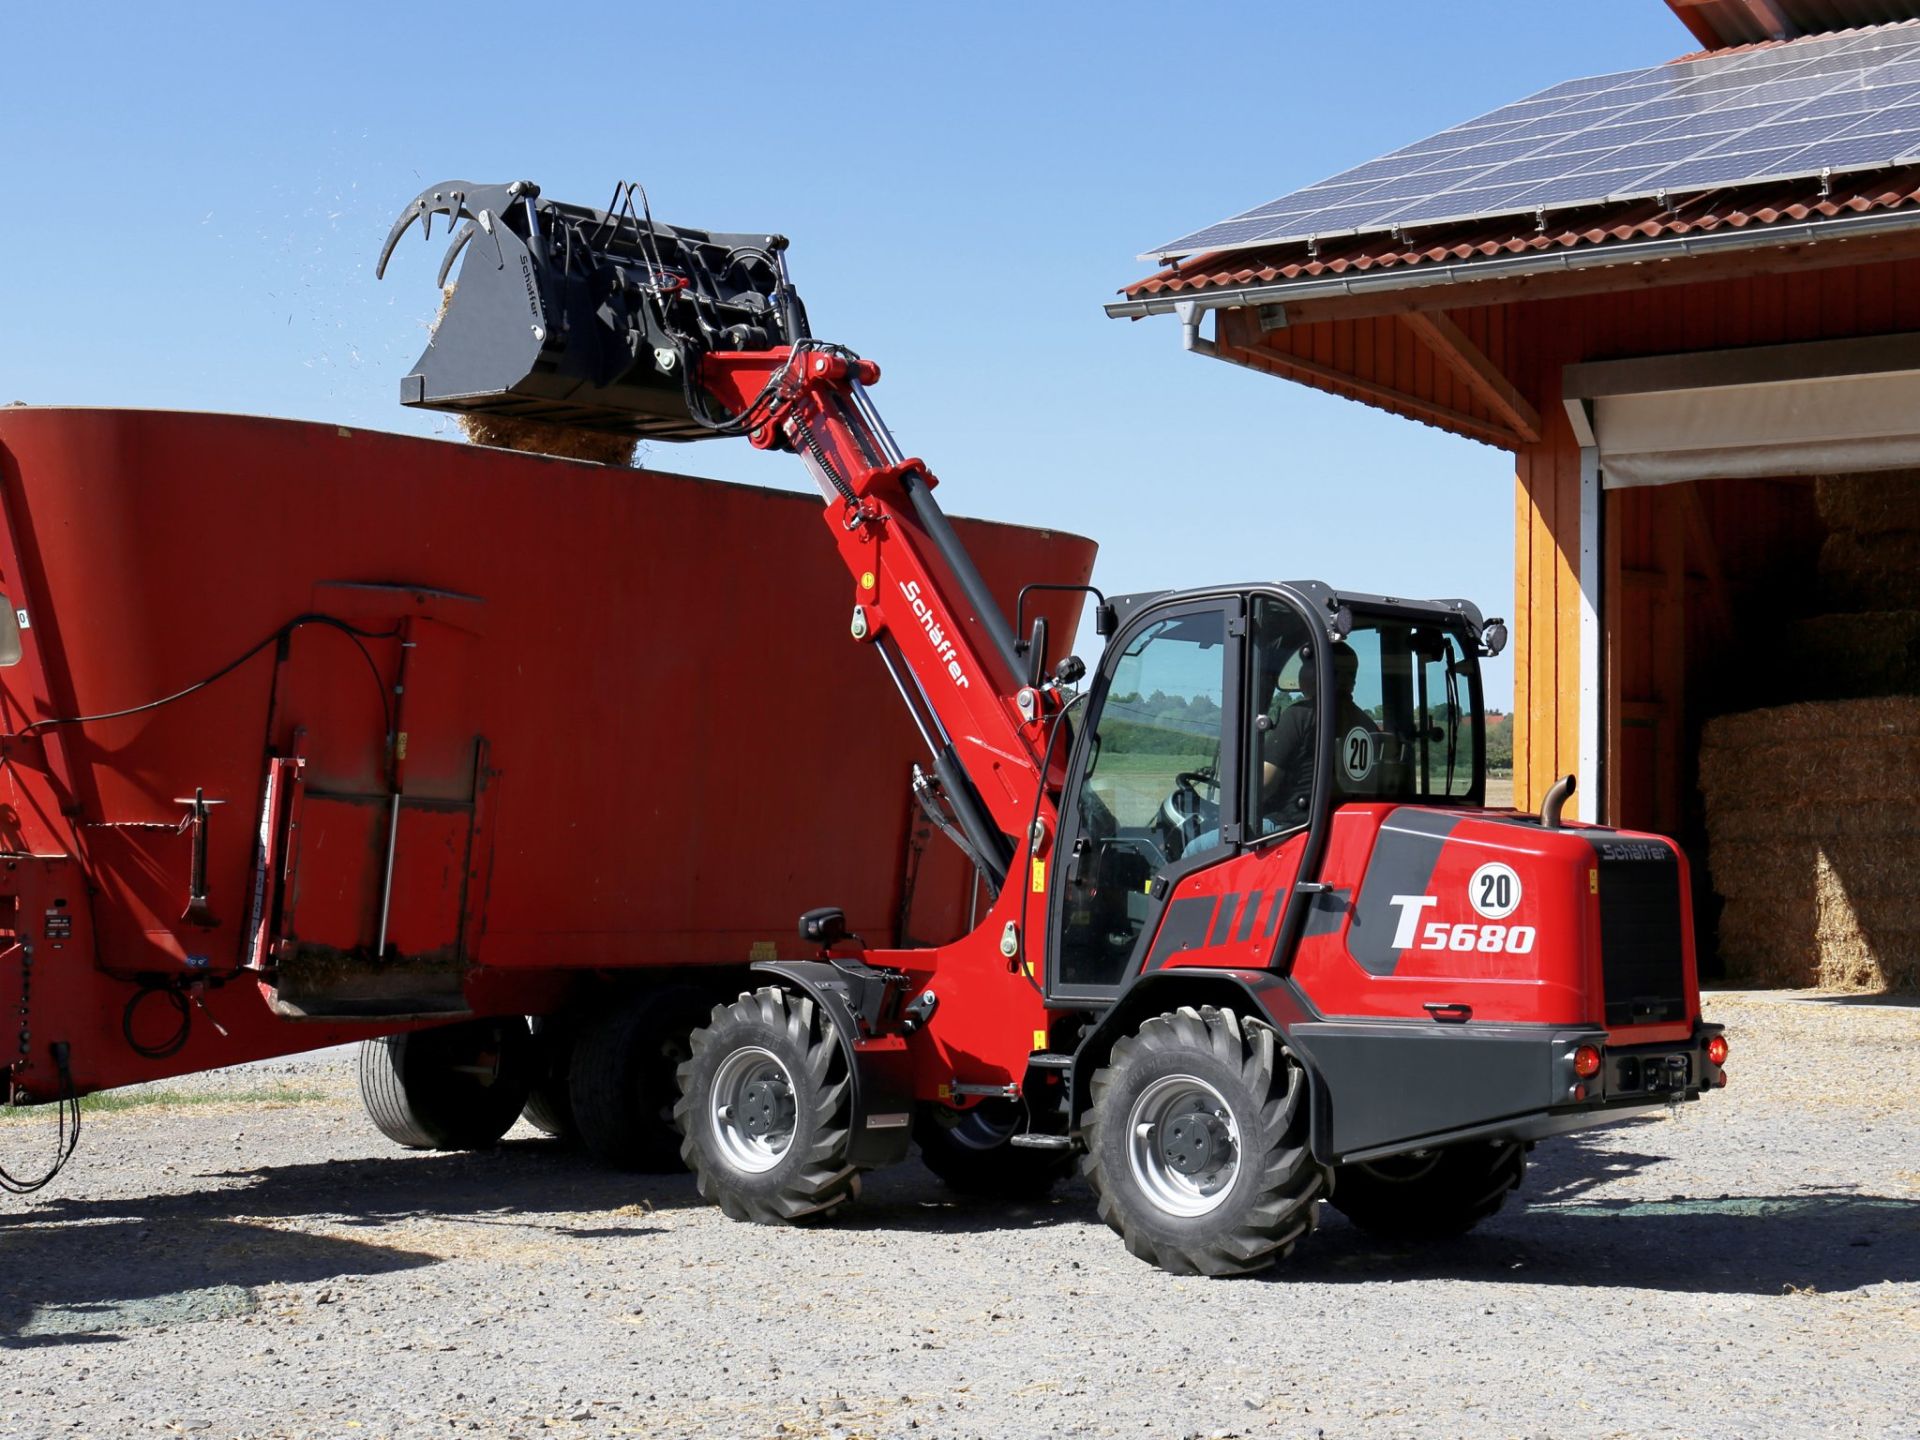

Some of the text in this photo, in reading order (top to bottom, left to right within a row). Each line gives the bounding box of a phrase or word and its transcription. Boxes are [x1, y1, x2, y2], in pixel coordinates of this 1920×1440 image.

[899, 580, 969, 689] Schäffer
[1350, 737, 1368, 771] 20
[1602, 844, 1666, 860] Schäffer
[1480, 874, 1511, 908] 20
